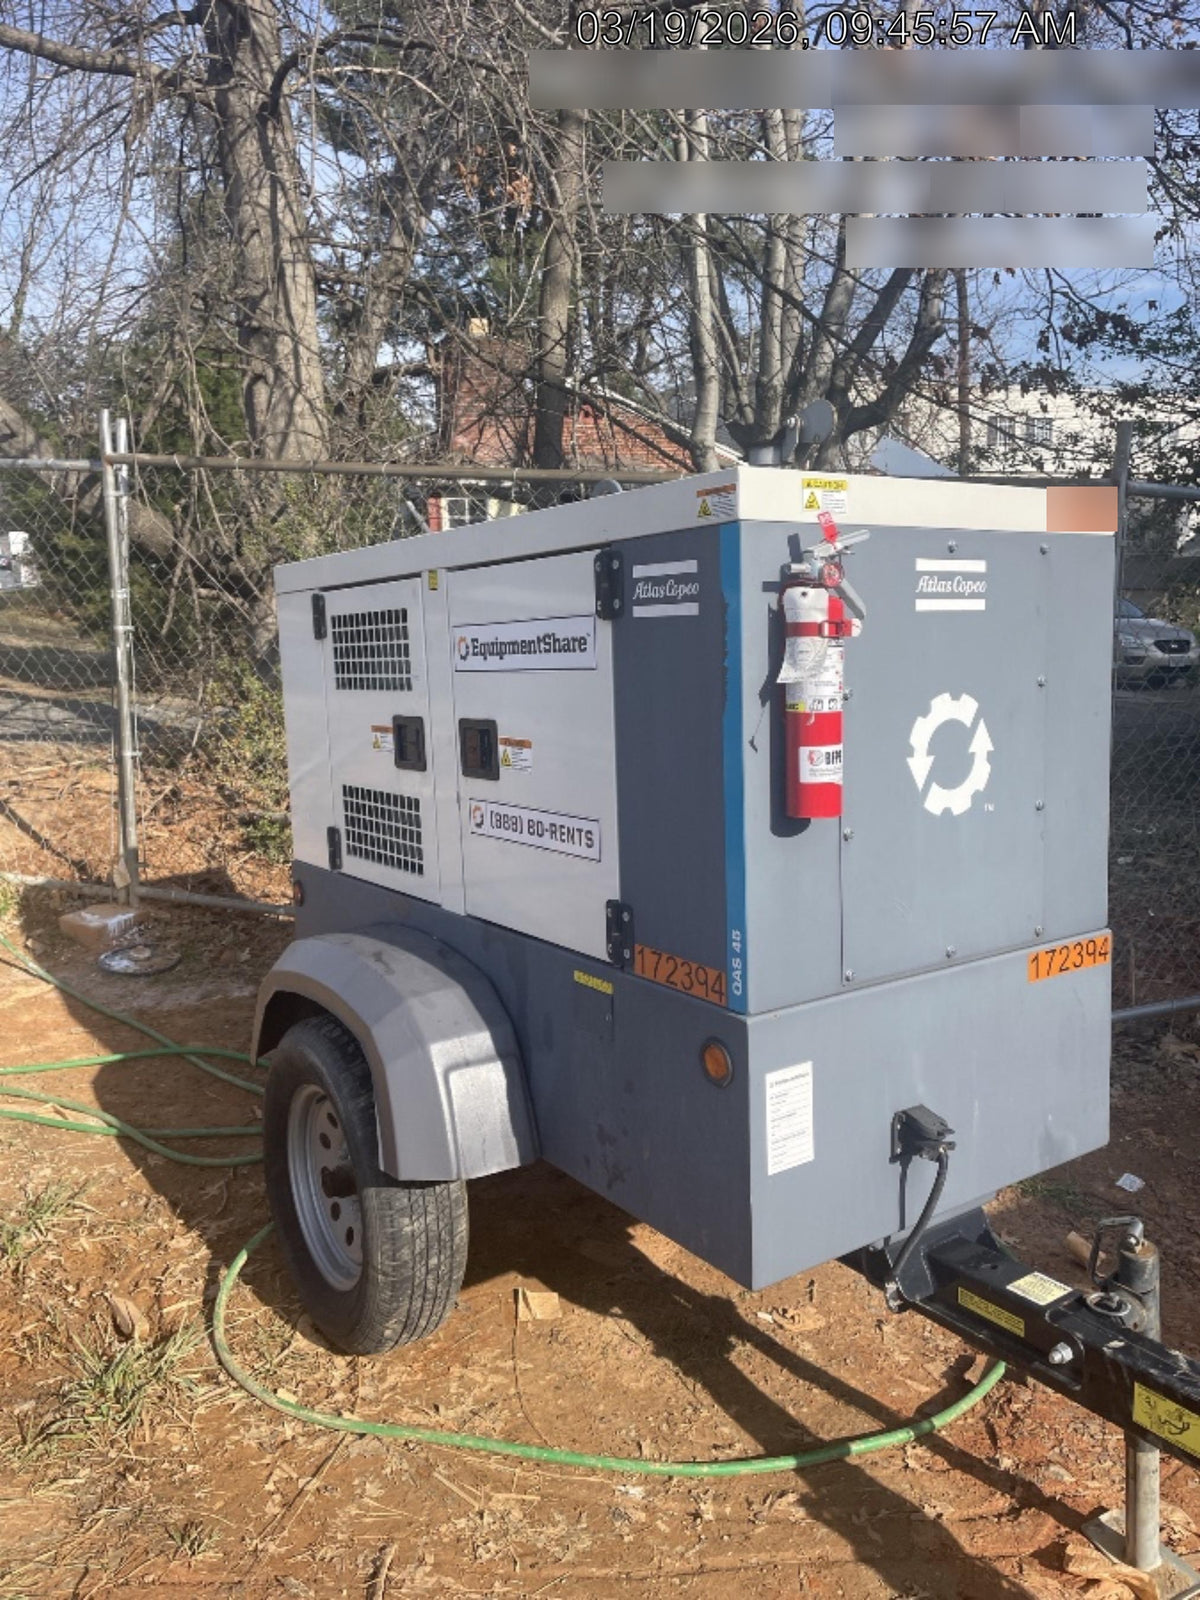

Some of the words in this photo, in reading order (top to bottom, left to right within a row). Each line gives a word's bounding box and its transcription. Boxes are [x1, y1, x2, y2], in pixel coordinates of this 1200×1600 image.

[632, 581, 665, 600] Atlas
[666, 579, 699, 600] Copco
[915, 575, 952, 593] Atlas
[952, 575, 987, 597] Copco
[471, 632, 588, 661] EquipmentShare
[490, 810, 524, 835] (888)
[527, 819, 595, 849] 80-RENTS
[638, 946, 725, 1003] 172394
[1031, 936, 1108, 979] 172394
